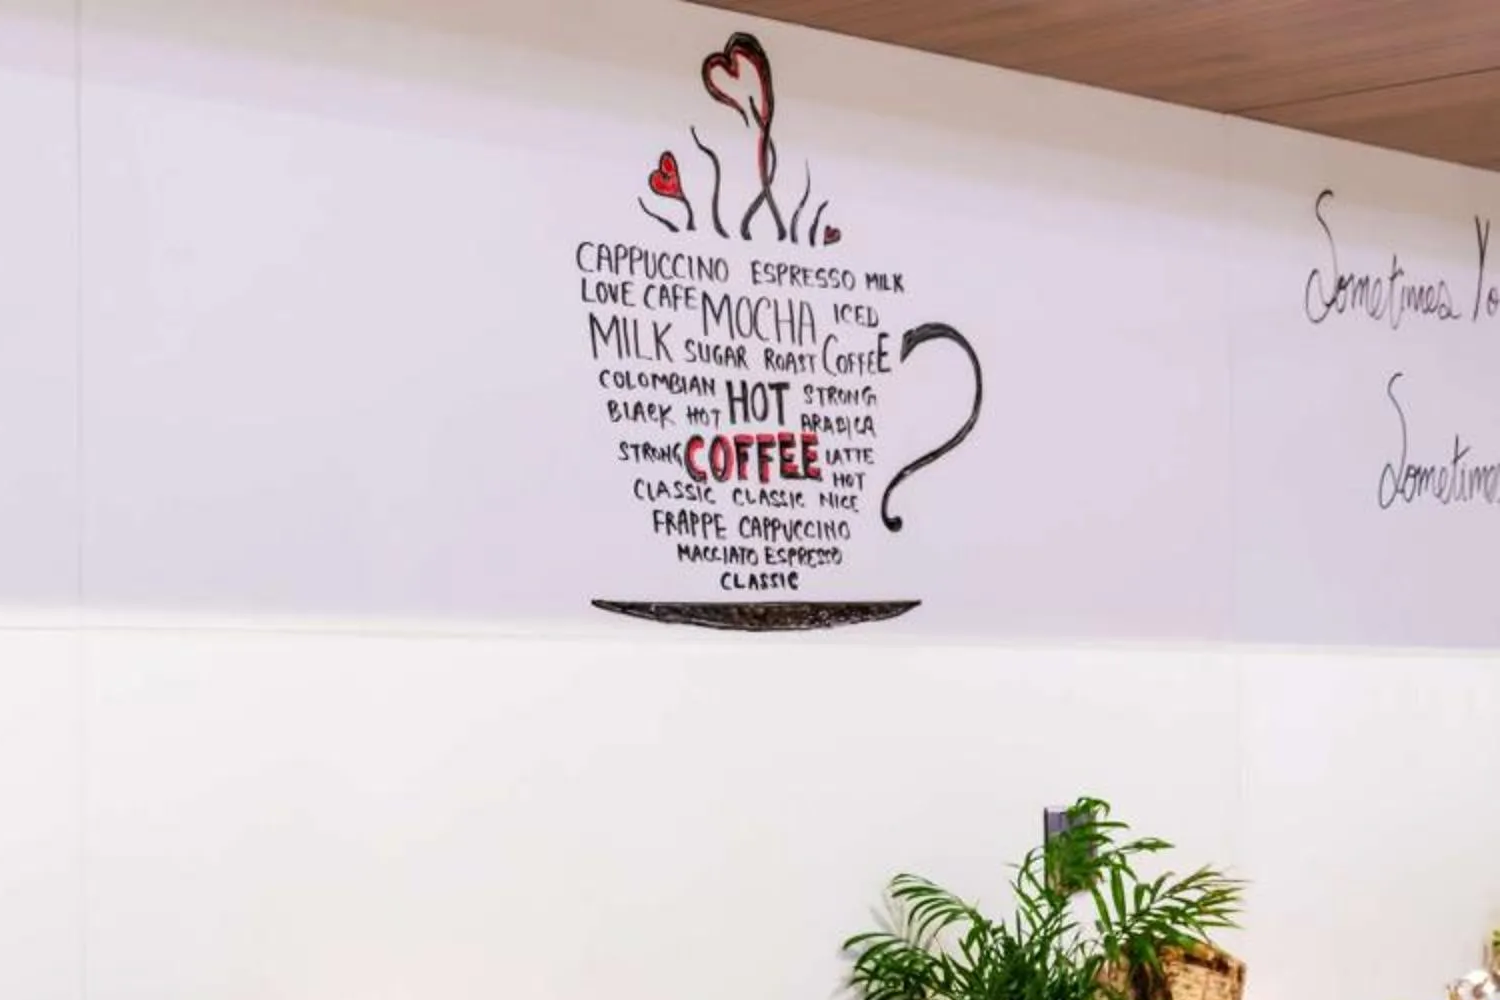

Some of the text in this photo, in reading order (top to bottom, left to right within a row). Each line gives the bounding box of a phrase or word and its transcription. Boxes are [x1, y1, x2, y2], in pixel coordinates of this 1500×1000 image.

[576, 241, 905, 293] CAPPUCCINO ESPRESSO MILK
[581, 278, 880, 347] LOVE CAFE MOCHA ICED
[588, 312, 674, 363] MILK
[684, 338, 750, 369] SUGAR
[763, 347, 816, 376] ROAST
[598, 369, 878, 426] COLOMBIAN HOT STRONG
[607, 400, 877, 437] BLACK HOT ARABICA
[617, 432, 875, 484] STRONG COFFEE LATTE
[1378, 371, 1500, 511] Sometime
[633, 478, 861, 513] CLASSIC CLASSIC NICE
[833, 472, 867, 491] HOT
[652, 508, 852, 542] FRAPPE CAPPUCCINO
[677, 545, 843, 568] MACCIATO ESPRESSO
[719, 571, 800, 592] CLASSIC
